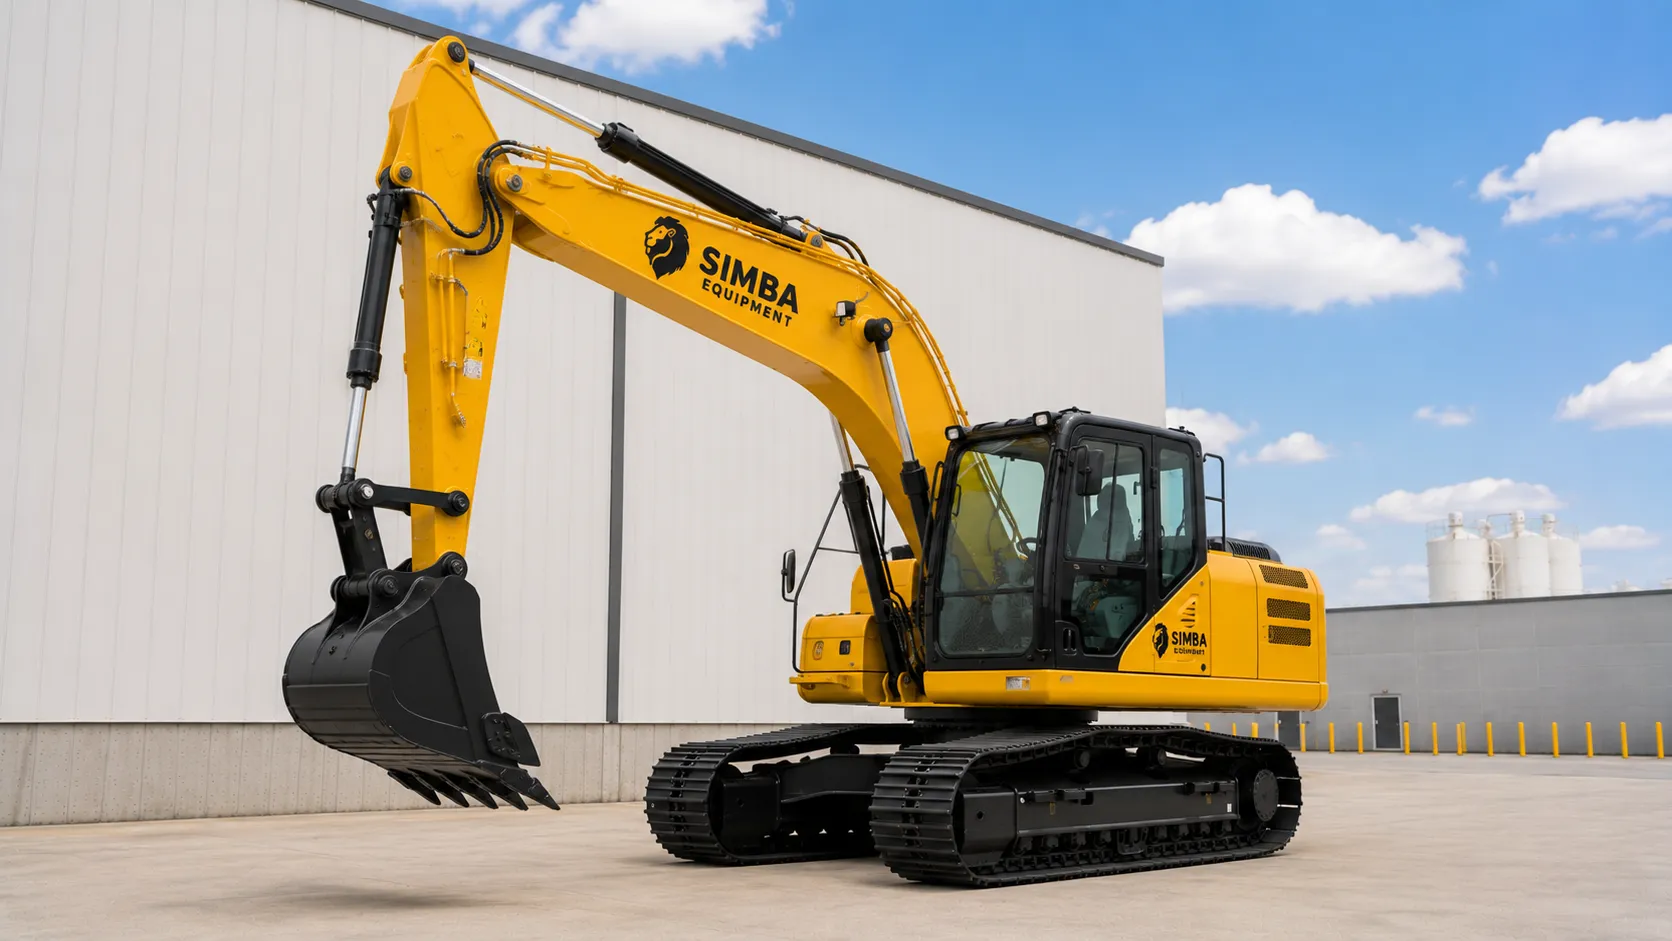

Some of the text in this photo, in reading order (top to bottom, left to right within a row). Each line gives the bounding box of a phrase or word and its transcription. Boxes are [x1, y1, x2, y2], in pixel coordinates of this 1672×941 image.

[699, 246, 799, 314] SIMBA
[702, 278, 792, 327] EQUIPMENT
[1171, 631, 1207, 648] SIMBA
